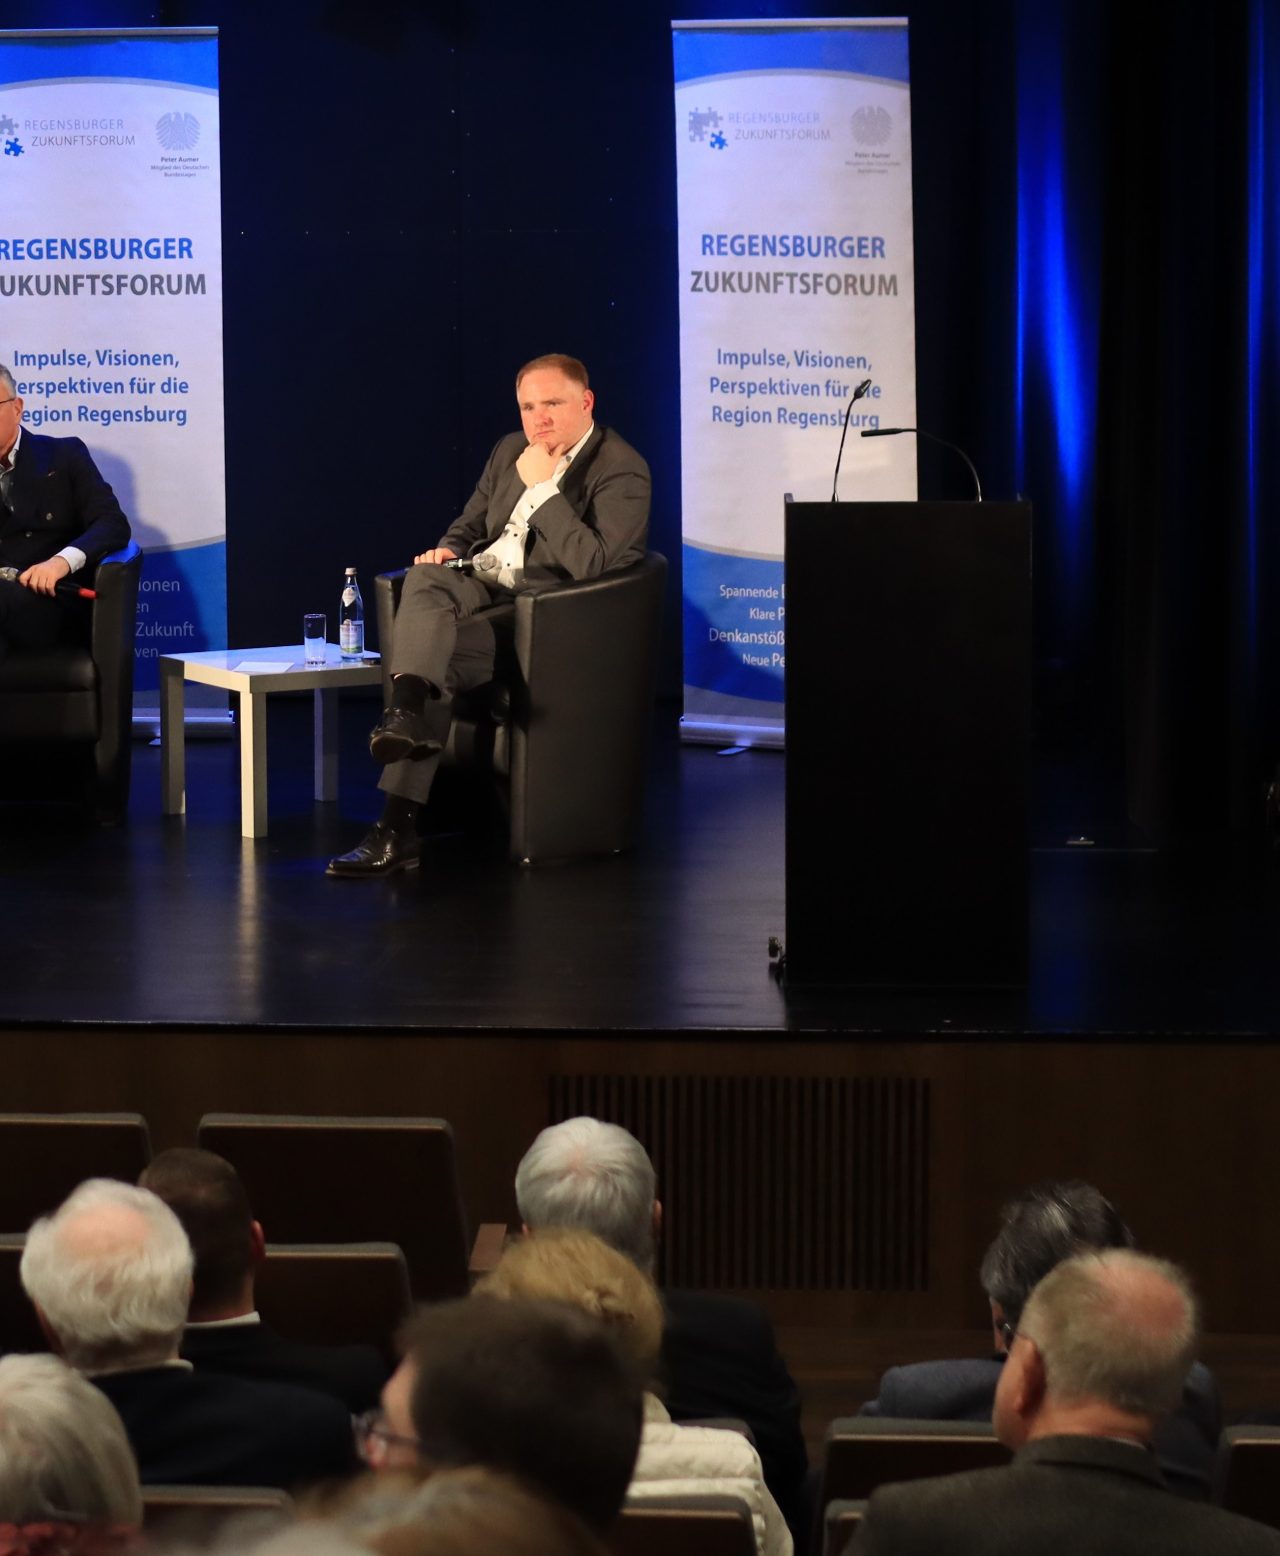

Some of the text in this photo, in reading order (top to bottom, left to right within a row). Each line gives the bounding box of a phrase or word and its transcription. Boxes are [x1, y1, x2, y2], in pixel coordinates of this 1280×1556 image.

[24, 118, 124, 131] REGENSBURGER
[728, 112, 820, 124] REGENSBURGER
[31, 135, 136, 147] ZUKUNFTSFORUM
[734, 129, 831, 141] ZUKUNFTSFORUM
[701, 234, 886, 259] REGENSBURGER
[690, 271, 899, 296] ZUKUNFTSFORUM
[14, 349, 179, 370] Impulse, Visionen,
[717, 348, 873, 372] Impulse, Visionen,
[17, 377, 189, 398] erspektiven für die
[710, 377, 820, 398] Perspektiven
[825, 379, 850, 397] für
[21, 405, 187, 426] egion Regensburg
[712, 405, 880, 430] Region Regensburg
[719, 584, 779, 599] Spannende
[749, 607, 776, 620] Klare
[135, 621, 195, 637] Zukunft
[709, 627, 785, 646] Denkanstöß
[742, 653, 770, 667] Neue
